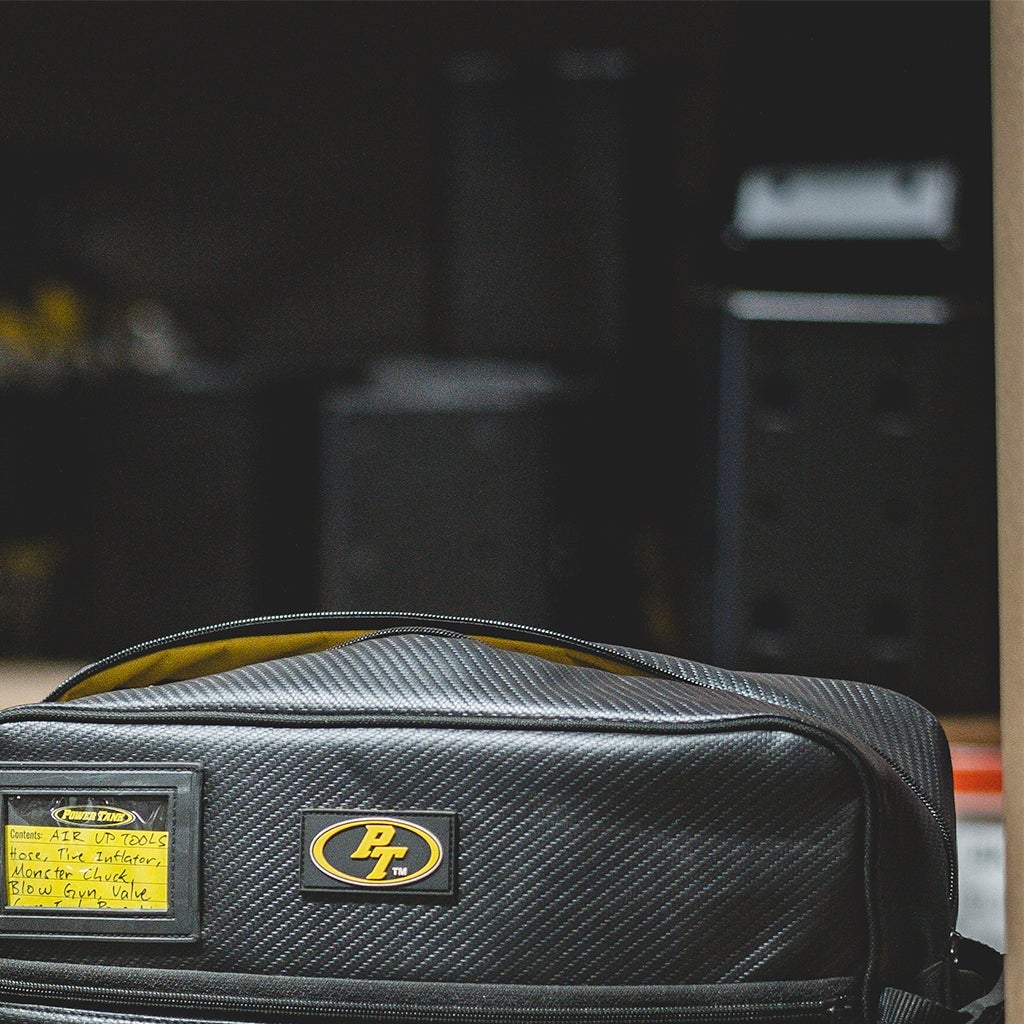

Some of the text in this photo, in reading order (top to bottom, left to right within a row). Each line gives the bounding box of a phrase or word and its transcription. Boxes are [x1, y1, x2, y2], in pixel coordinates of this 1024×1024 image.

[10, 829, 43, 841] Contents:
[49, 831, 168, 848] AIR UP TOOLS
[10, 846, 162, 868] Hose, Tire Inflator,
[12, 864, 73, 880] Monster
[8, 880, 52, 895] Blow
[113, 882, 151, 901] Valve
